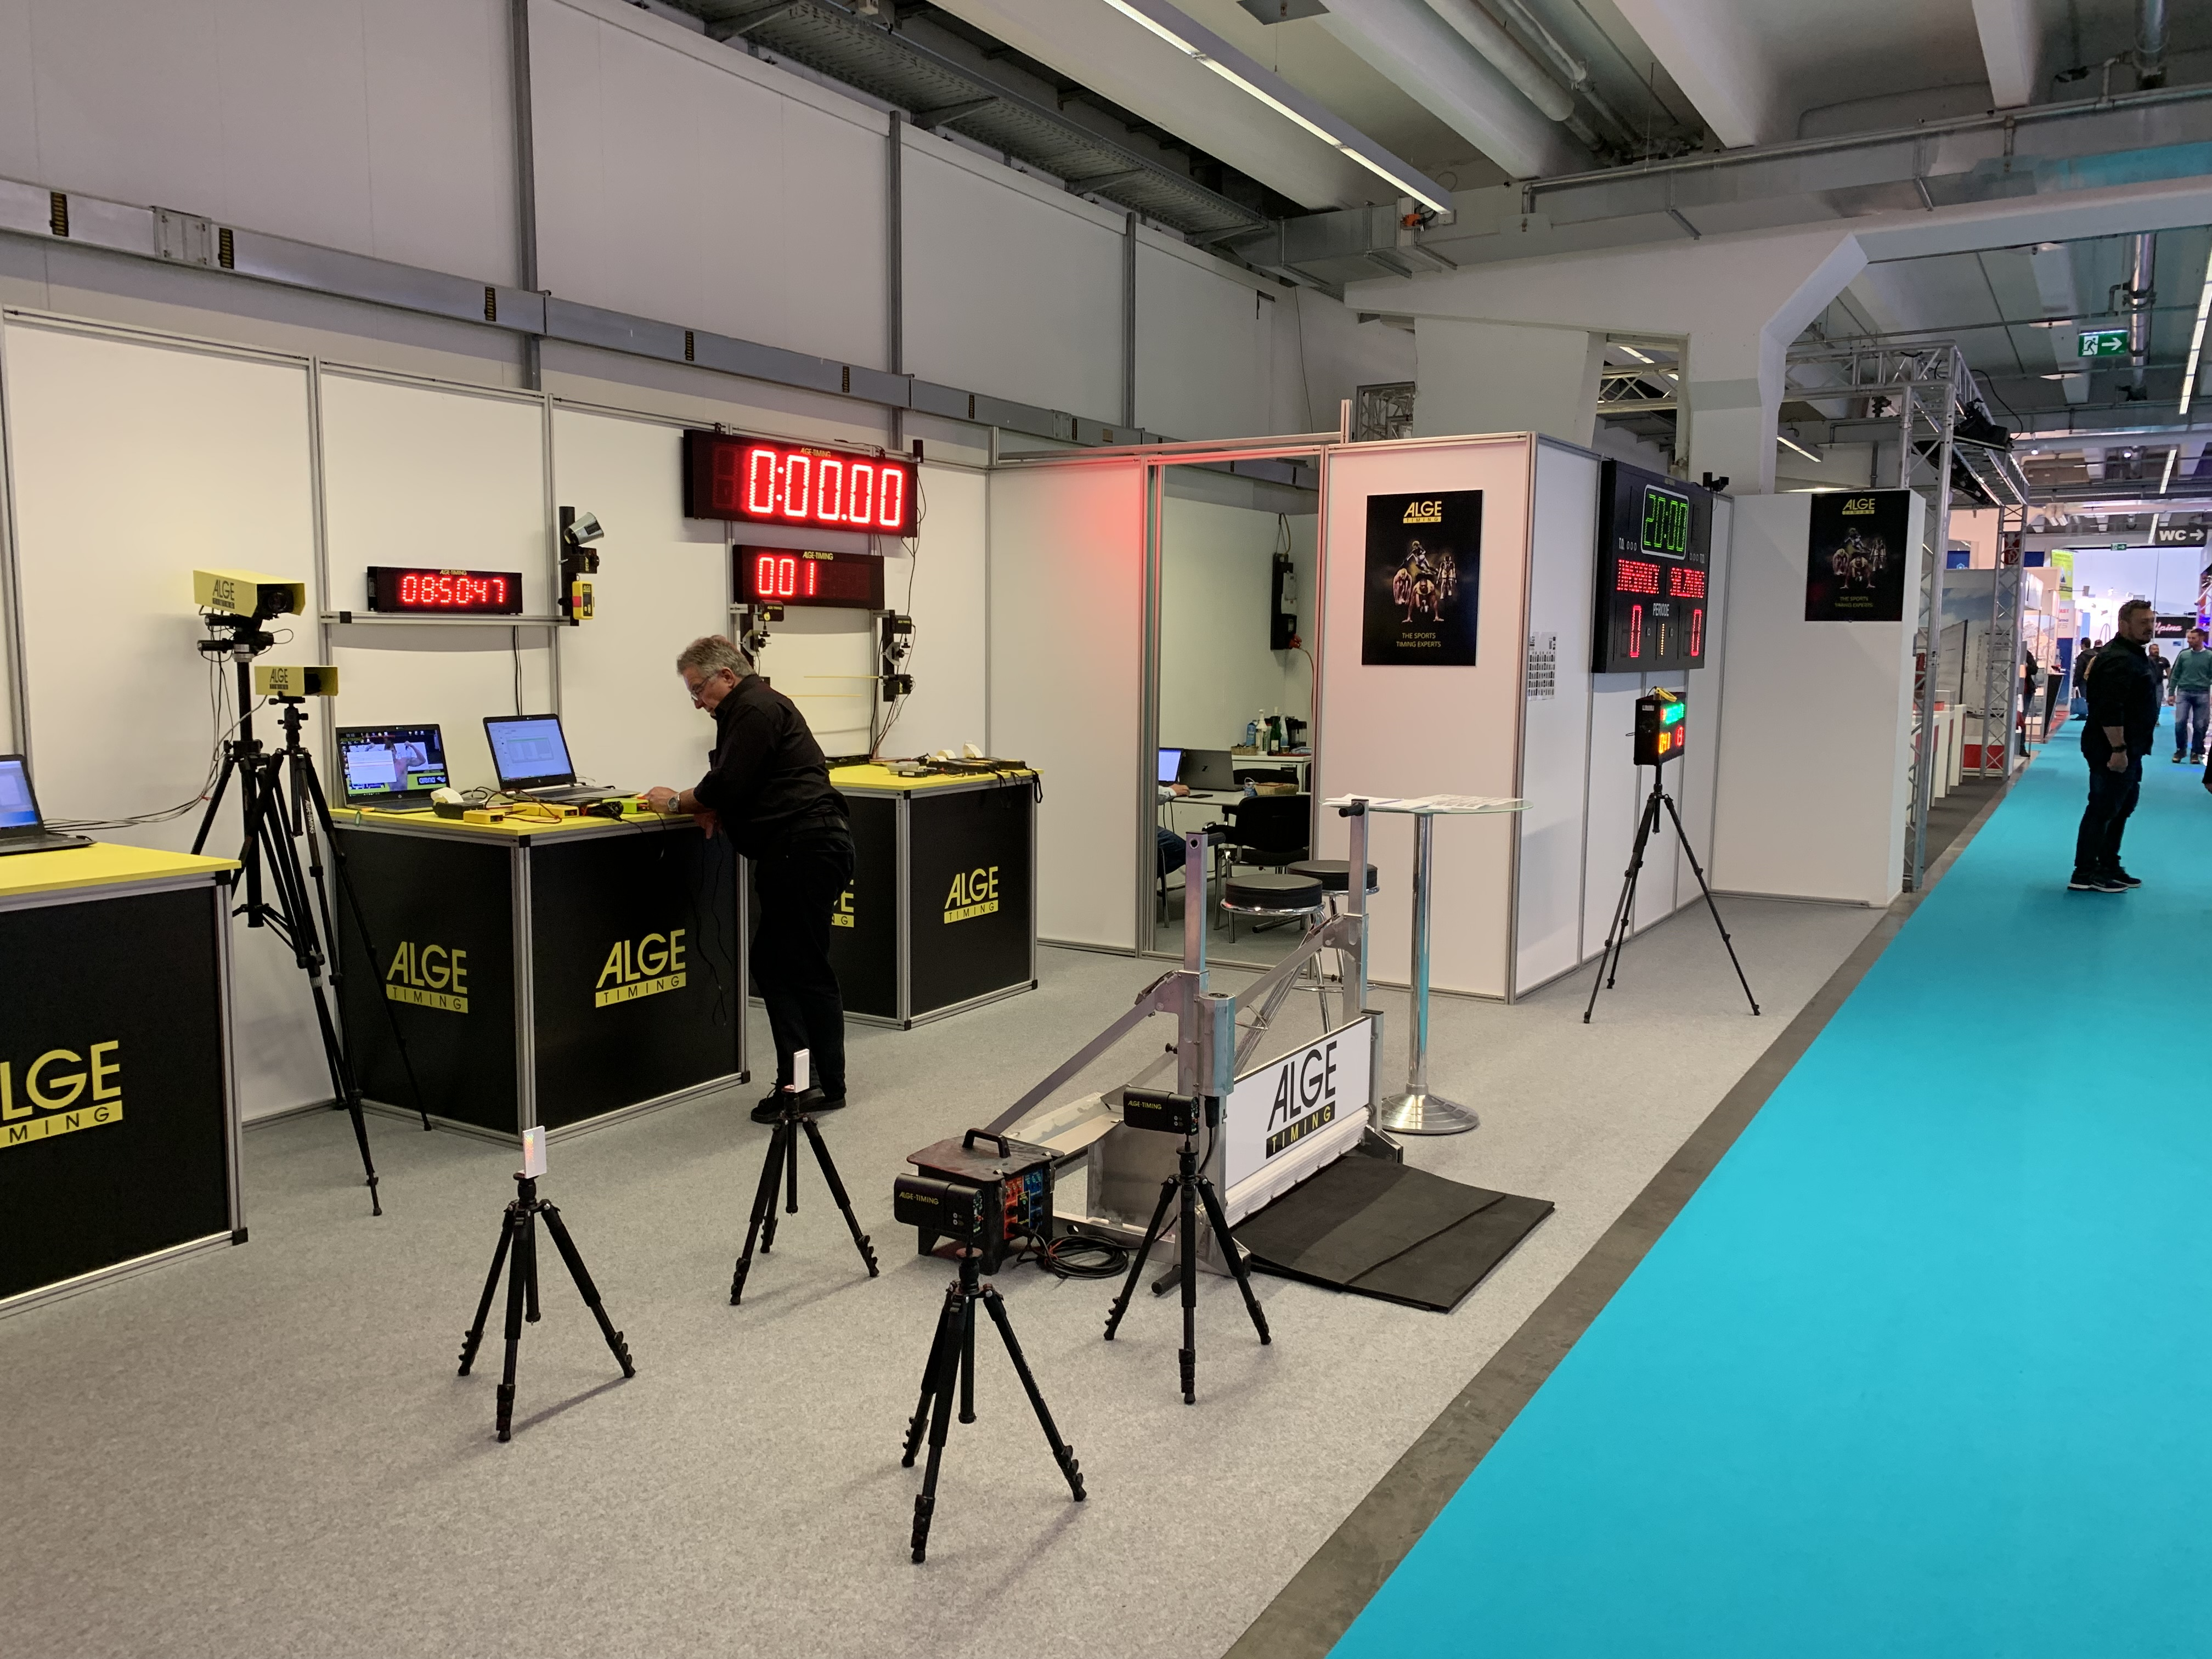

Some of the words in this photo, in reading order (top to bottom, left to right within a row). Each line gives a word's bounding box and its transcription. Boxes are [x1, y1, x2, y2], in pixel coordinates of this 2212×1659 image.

[749, 450, 903, 526] 0:00.00
[1403, 501, 1442, 517] ALGE
[1843, 498, 1876, 511] ALGE
[1644, 493, 1689, 552] 20:00
[2159, 529, 2187, 541] WC
[803, 551, 833, 560] ALGE-TIMING
[212, 579, 235, 601] ALGE
[402, 576, 504, 603] 08:50:47
[269, 668, 288, 684] ALGE
[944, 866, 998, 909] ALGE
[949, 902, 995, 922] TIMING
[386, 941, 467, 994] ALGE
[596, 929, 685, 989] ALGE
[393, 986, 461, 1010] TIMING
[603, 975, 680, 1003] TIMING
[0, 1040, 121, 1121] LGE
[1267, 1040, 1337, 1132] ALGE
[1127, 1099, 1162, 1110] ALGE-TIMING
[9, 1107, 109, 1143] MING
[1272, 1105, 1331, 1153] TIMING
[899, 1191, 939, 1205] ALGE-TIMING
